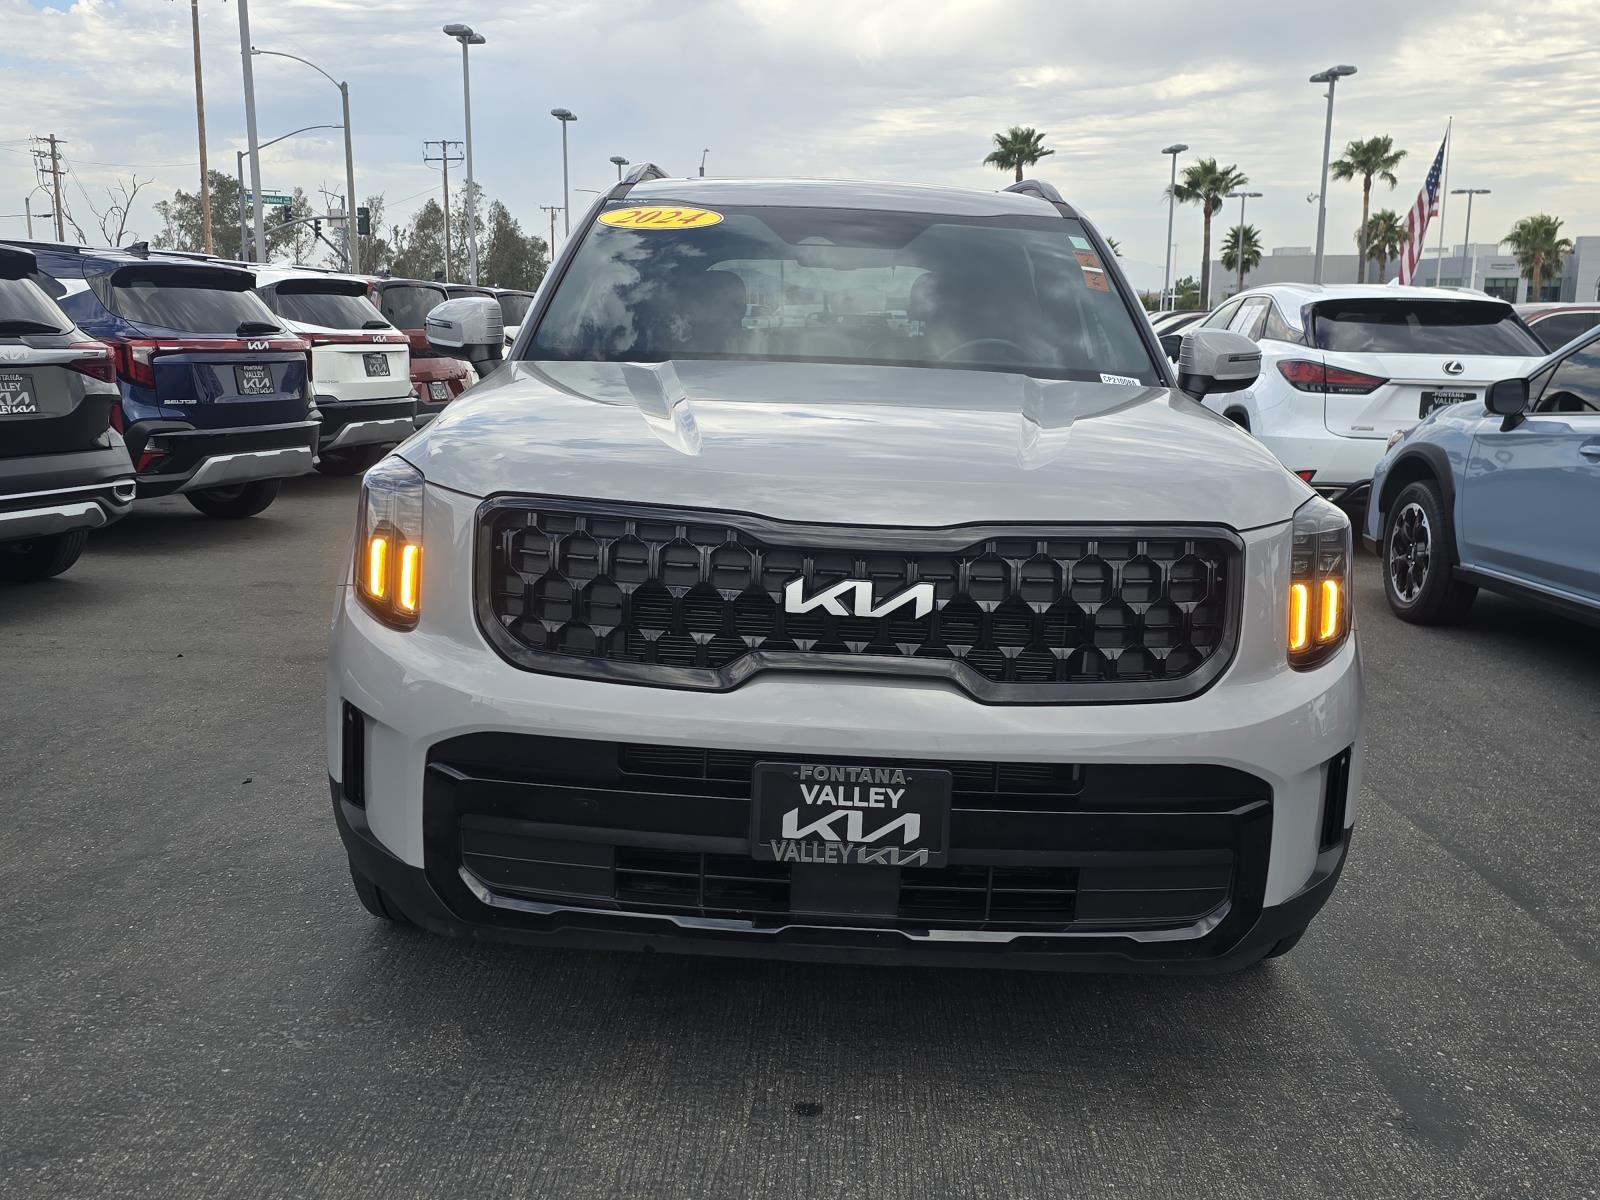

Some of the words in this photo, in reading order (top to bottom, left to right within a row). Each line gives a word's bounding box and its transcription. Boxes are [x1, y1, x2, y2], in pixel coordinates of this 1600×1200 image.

[613, 210, 707, 225] 2024
[247, 341, 270, 350] KIA
[0, 382, 21, 392] LLEY
[243, 377, 270, 389] KIA
[0, 391, 30, 406] IA
[784, 576, 935, 620] KIA
[800, 766, 907, 785] FONTANA
[800, 783, 906, 809] VALLEY
[781, 807, 921, 845] KIA
[770, 839, 854, 864] VALLEY
[857, 845, 929, 867] KIA
